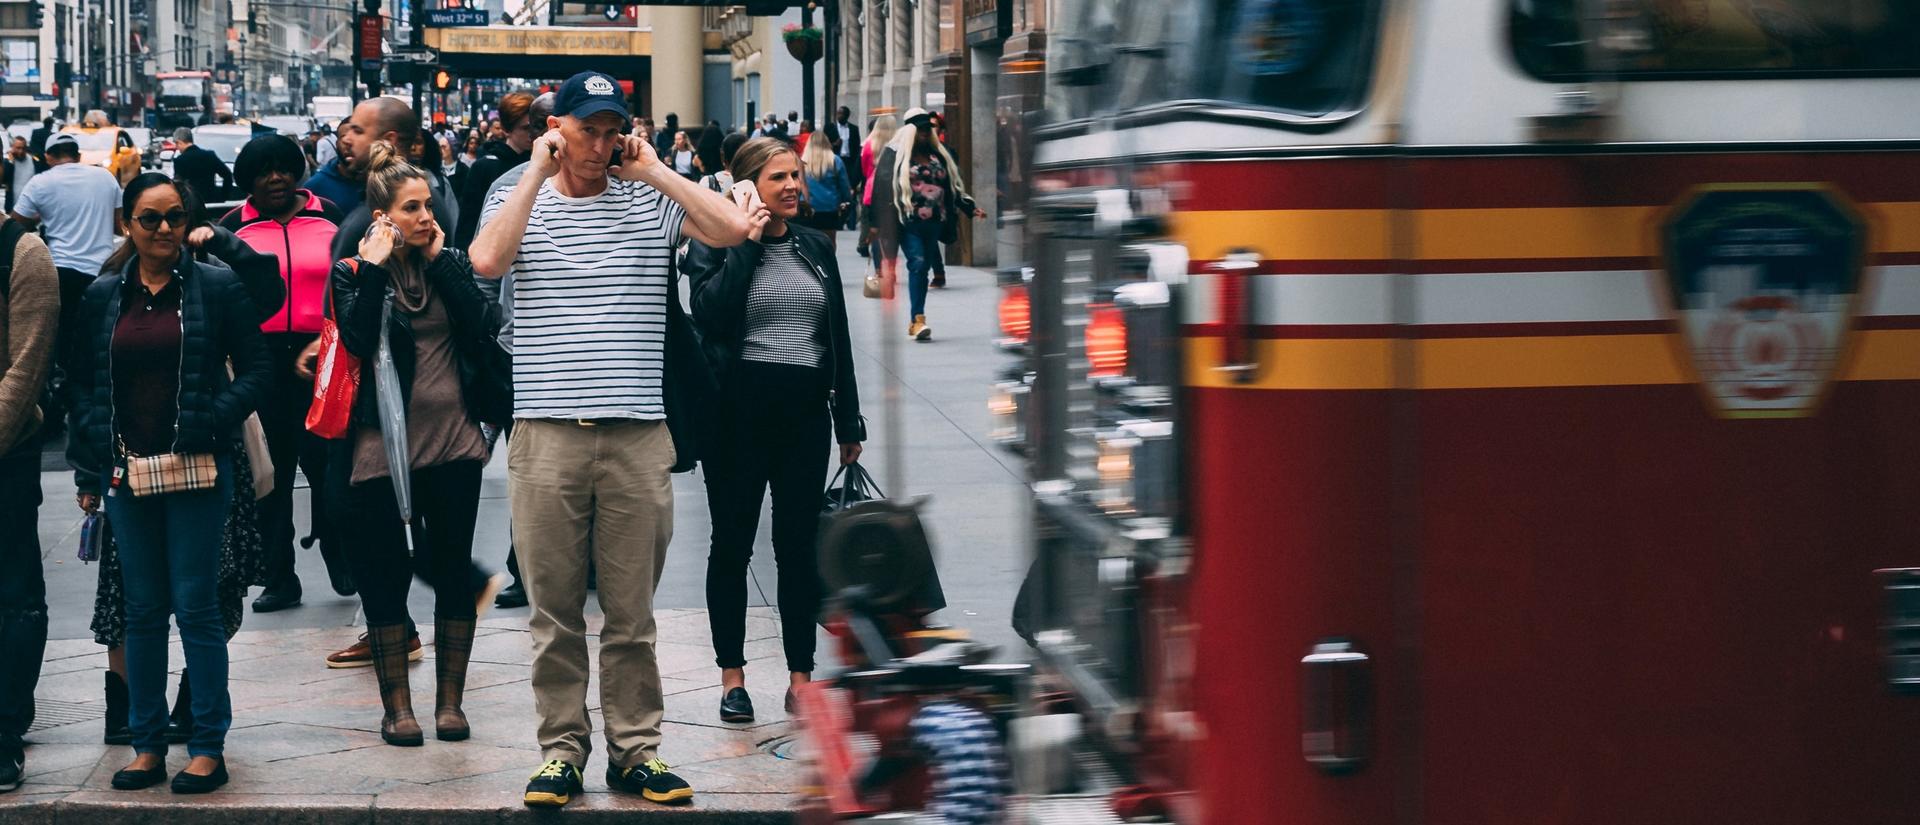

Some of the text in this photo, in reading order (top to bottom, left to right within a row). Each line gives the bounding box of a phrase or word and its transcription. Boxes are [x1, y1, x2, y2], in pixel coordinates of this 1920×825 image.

[432, 13, 484, 23] West 32nd St
[629, 6, 636, 18] 1
[448, 34, 627, 48] HOTEL PENNSYLVANIA
